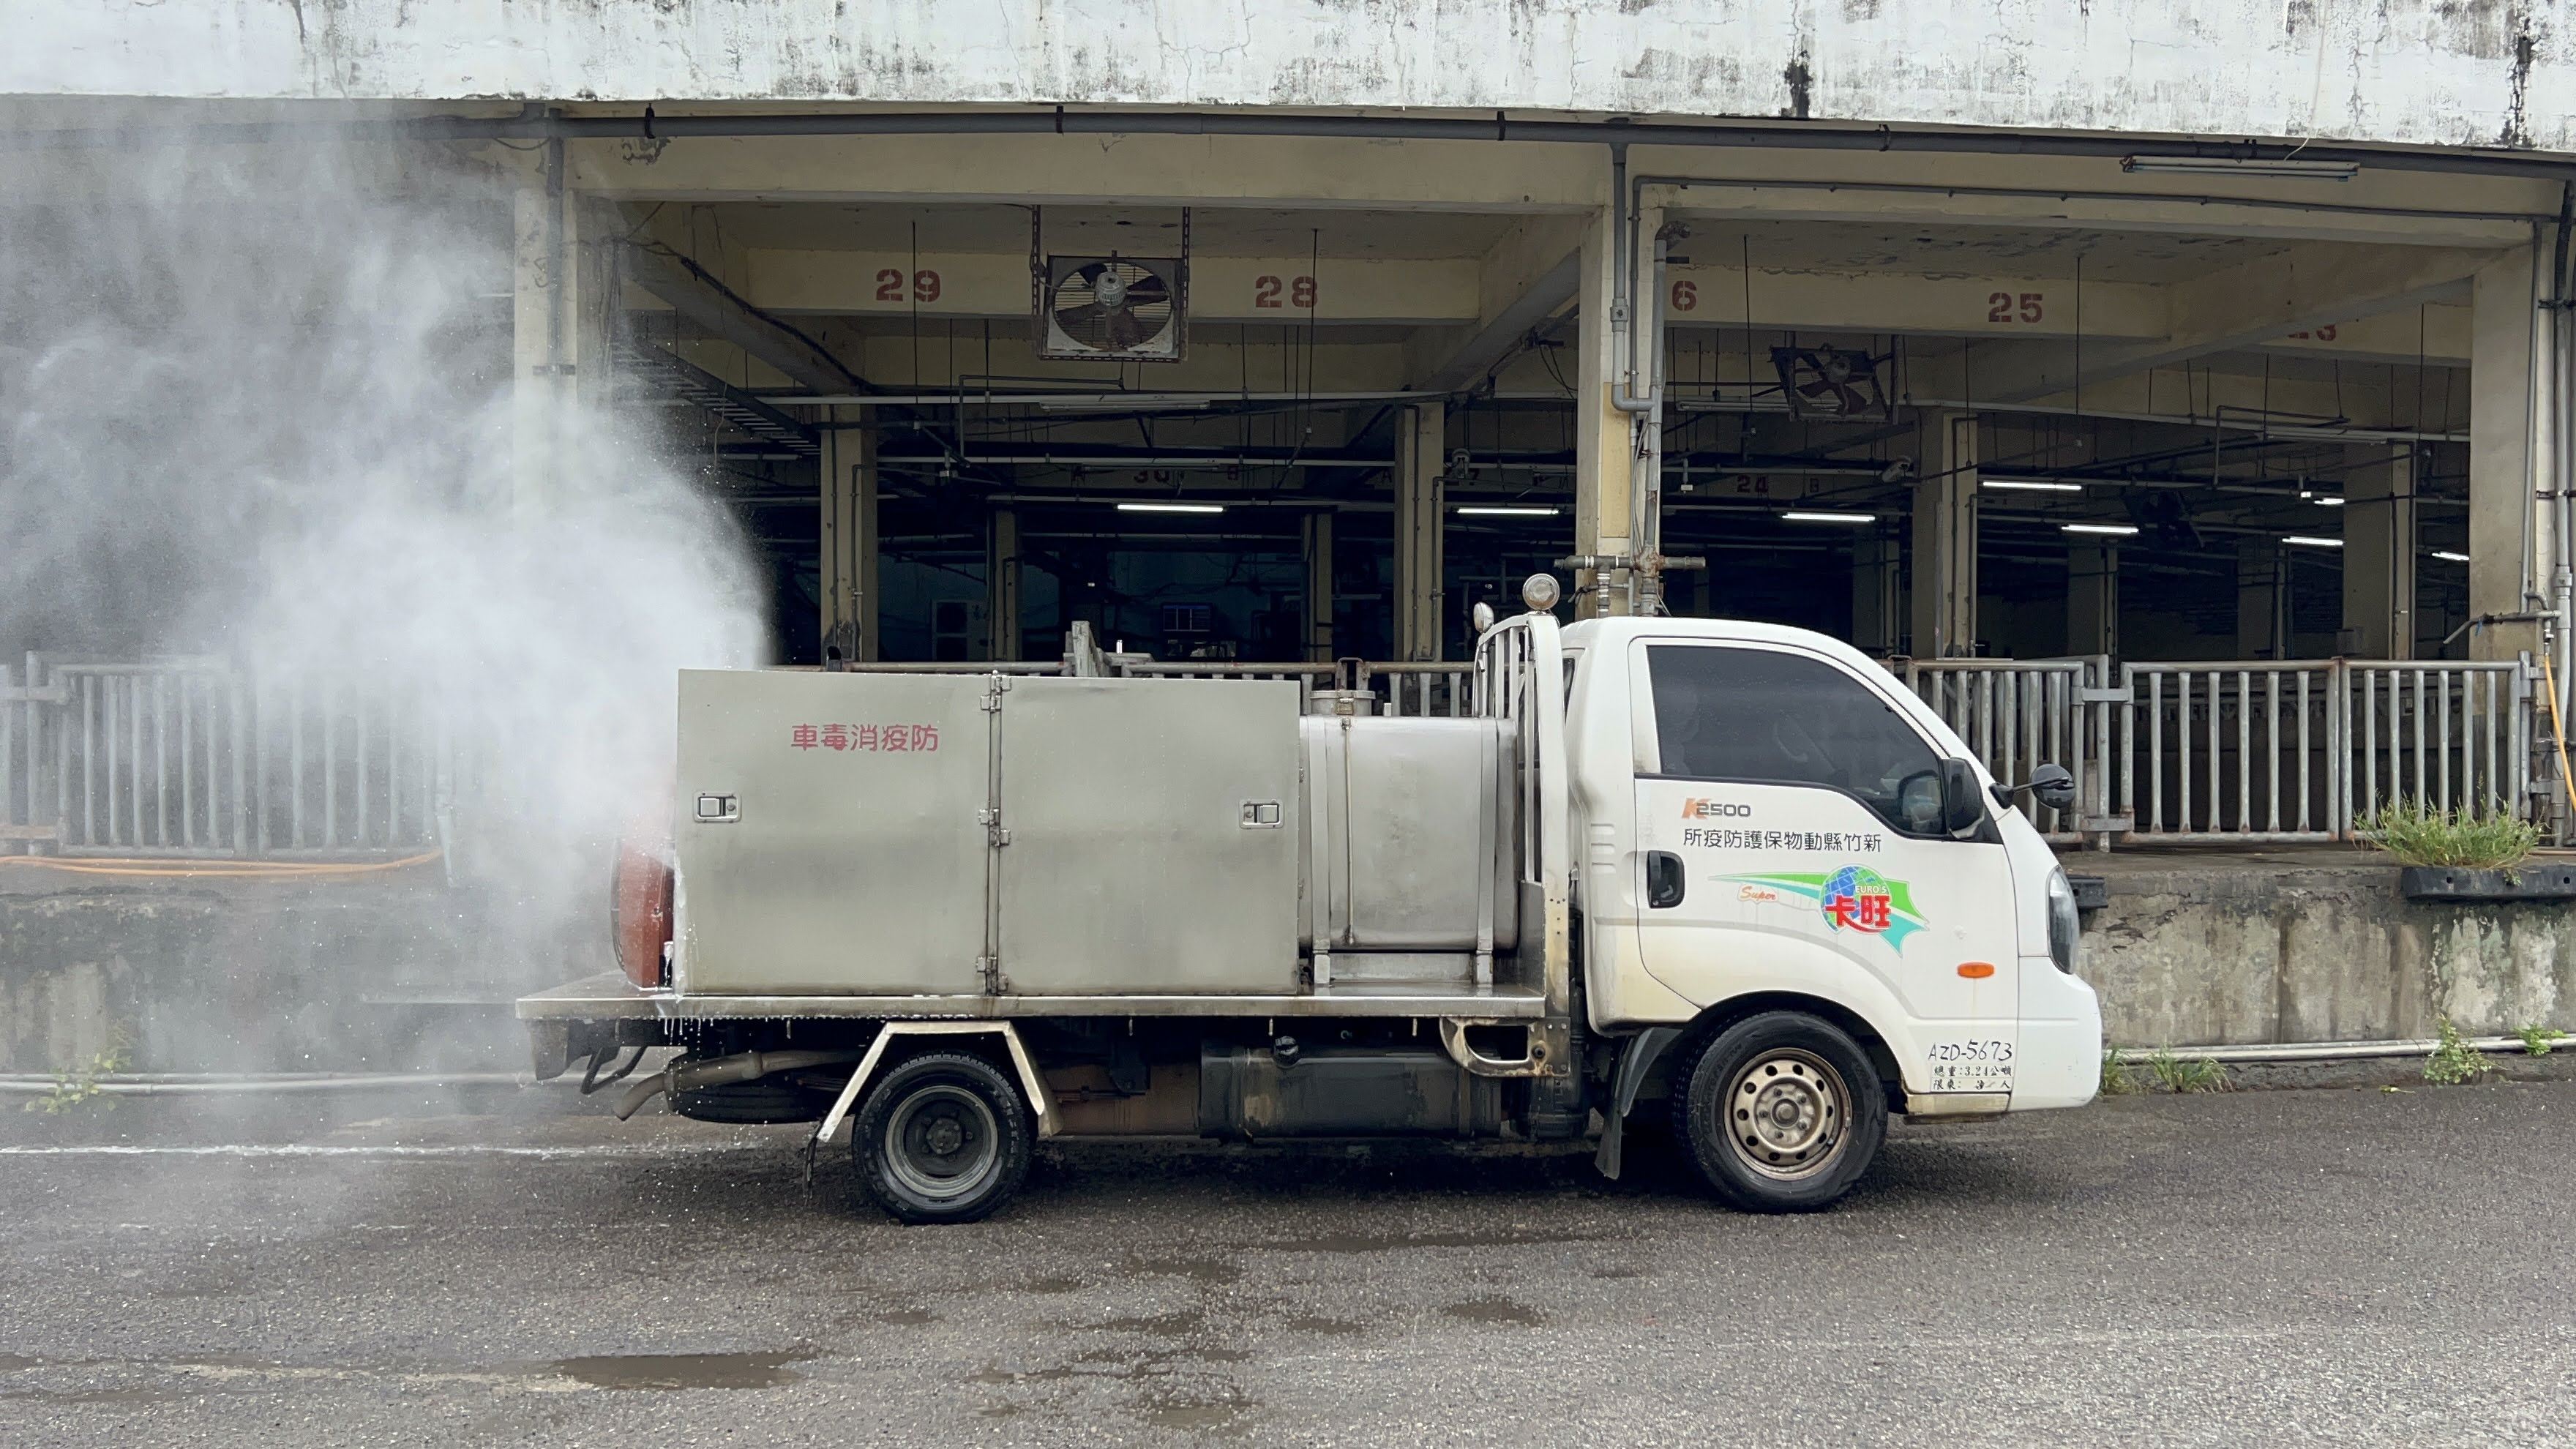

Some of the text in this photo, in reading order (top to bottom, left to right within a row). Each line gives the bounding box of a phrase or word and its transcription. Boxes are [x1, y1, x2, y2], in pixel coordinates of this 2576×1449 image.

[876, 269, 941, 302] 29
[1255, 275, 1317, 308] 28
[1988, 292, 2043, 323] 25
[1681, 798, 1751, 820] K2500
[1739, 886, 1776, 902] Super
[1855, 885, 1879, 894] EURO
[1825, 895, 1891, 931] 卡旺
[1928, 1038, 2012, 1062] AZD-5673
